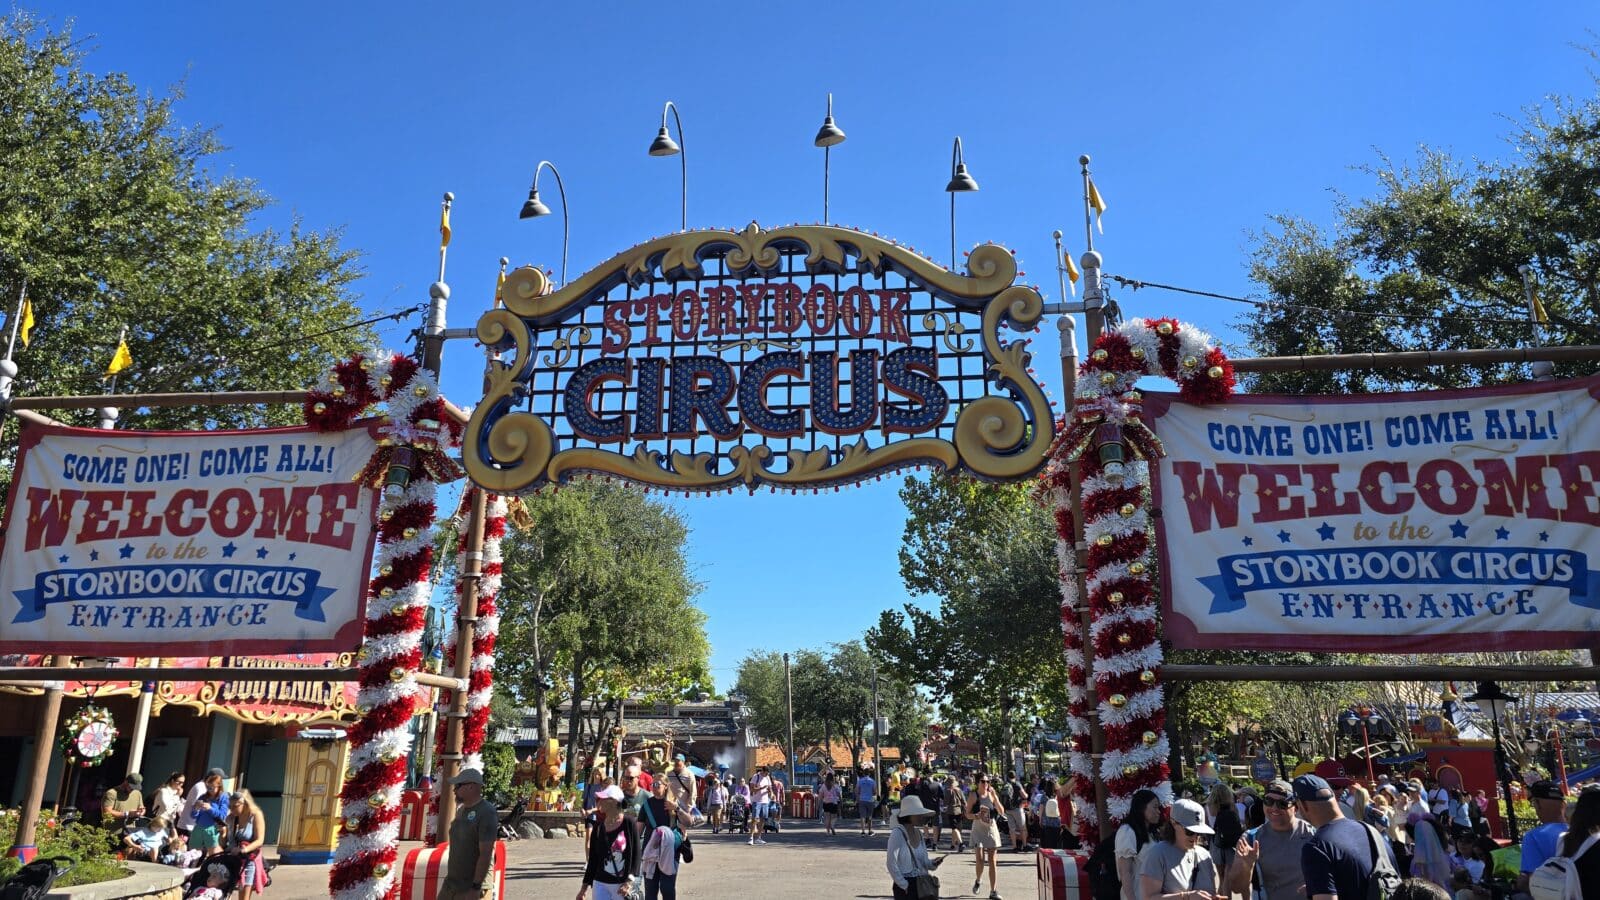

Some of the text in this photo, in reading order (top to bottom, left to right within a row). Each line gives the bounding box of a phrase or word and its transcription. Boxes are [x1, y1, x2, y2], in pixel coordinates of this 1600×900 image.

[601, 282, 913, 355] STORYBOOK
[563, 346, 949, 444] CIRCUS
[1207, 408, 1559, 457] COME ONE! COME ALL!
[63, 445, 335, 484] COME ONE! COME ALL!
[1172, 450, 1600, 534] WELCOME
[24, 482, 361, 552] WELCOME
[1353, 515, 1434, 542] to the
[146, 537, 209, 560] to the
[1231, 551, 1575, 588] STORYBOOK CIRCUS
[43, 567, 307, 600] STORYBOOK CIRCUS
